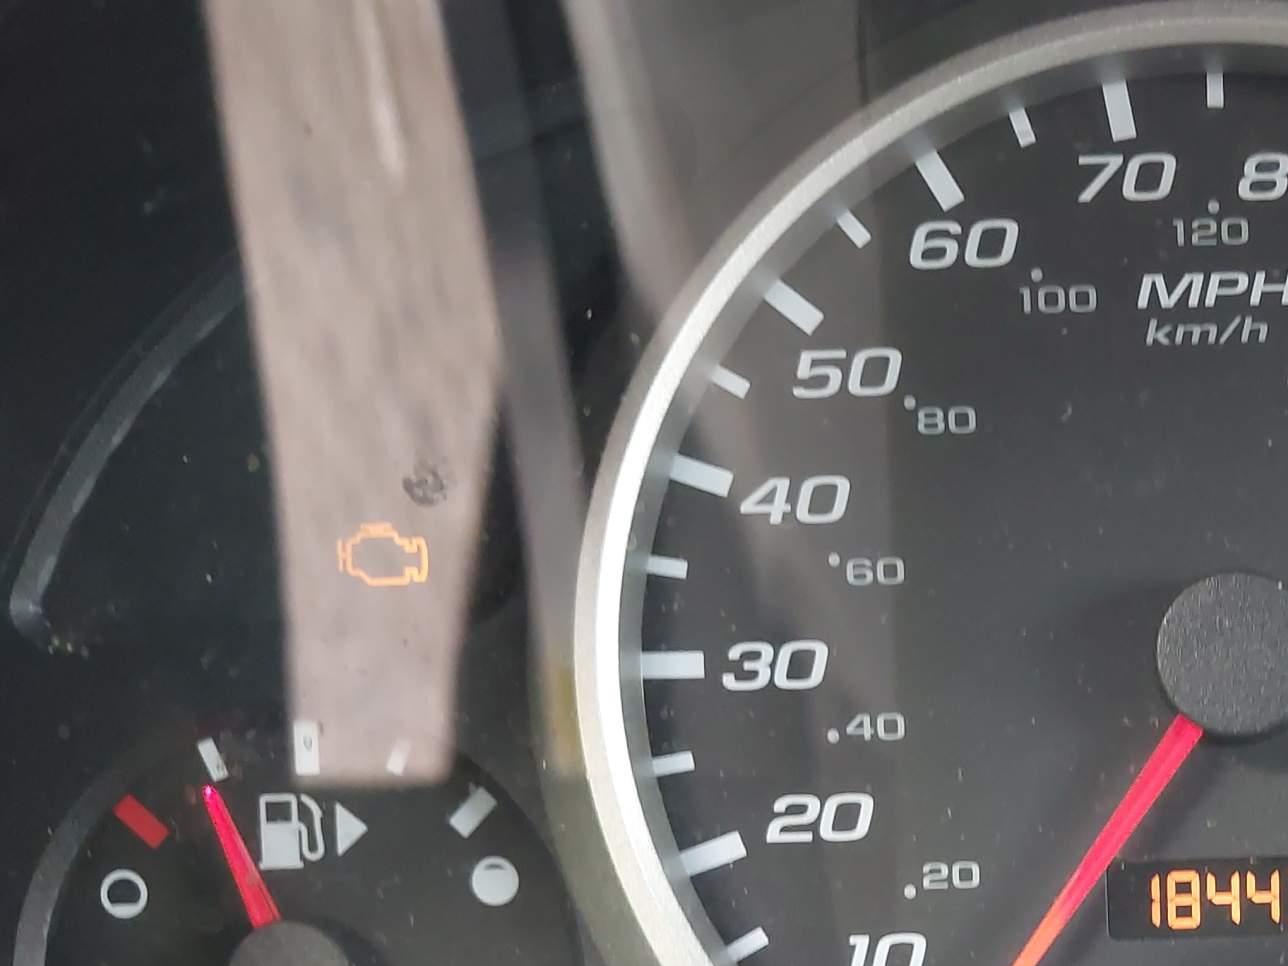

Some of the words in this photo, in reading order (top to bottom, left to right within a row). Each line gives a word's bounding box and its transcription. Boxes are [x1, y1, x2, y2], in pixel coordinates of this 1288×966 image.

[1077, 152, 1177, 203] 70
[909, 218, 1020, 269] 60
[1171, 217, 1250, 247] 120
[1018, 285, 1098, 314] 100
[1145, 317, 1269, 346] km/h
[792, 347, 902, 398] 50
[916, 405, 978, 434] 80
[739, 475, 851, 524] 40
[844, 556, 905, 585] 60
[721, 639, 829, 691] 30
[844, 712, 906, 741] 40
[766, 792, 874, 844] 20
[921, 860, 981, 890] 20
